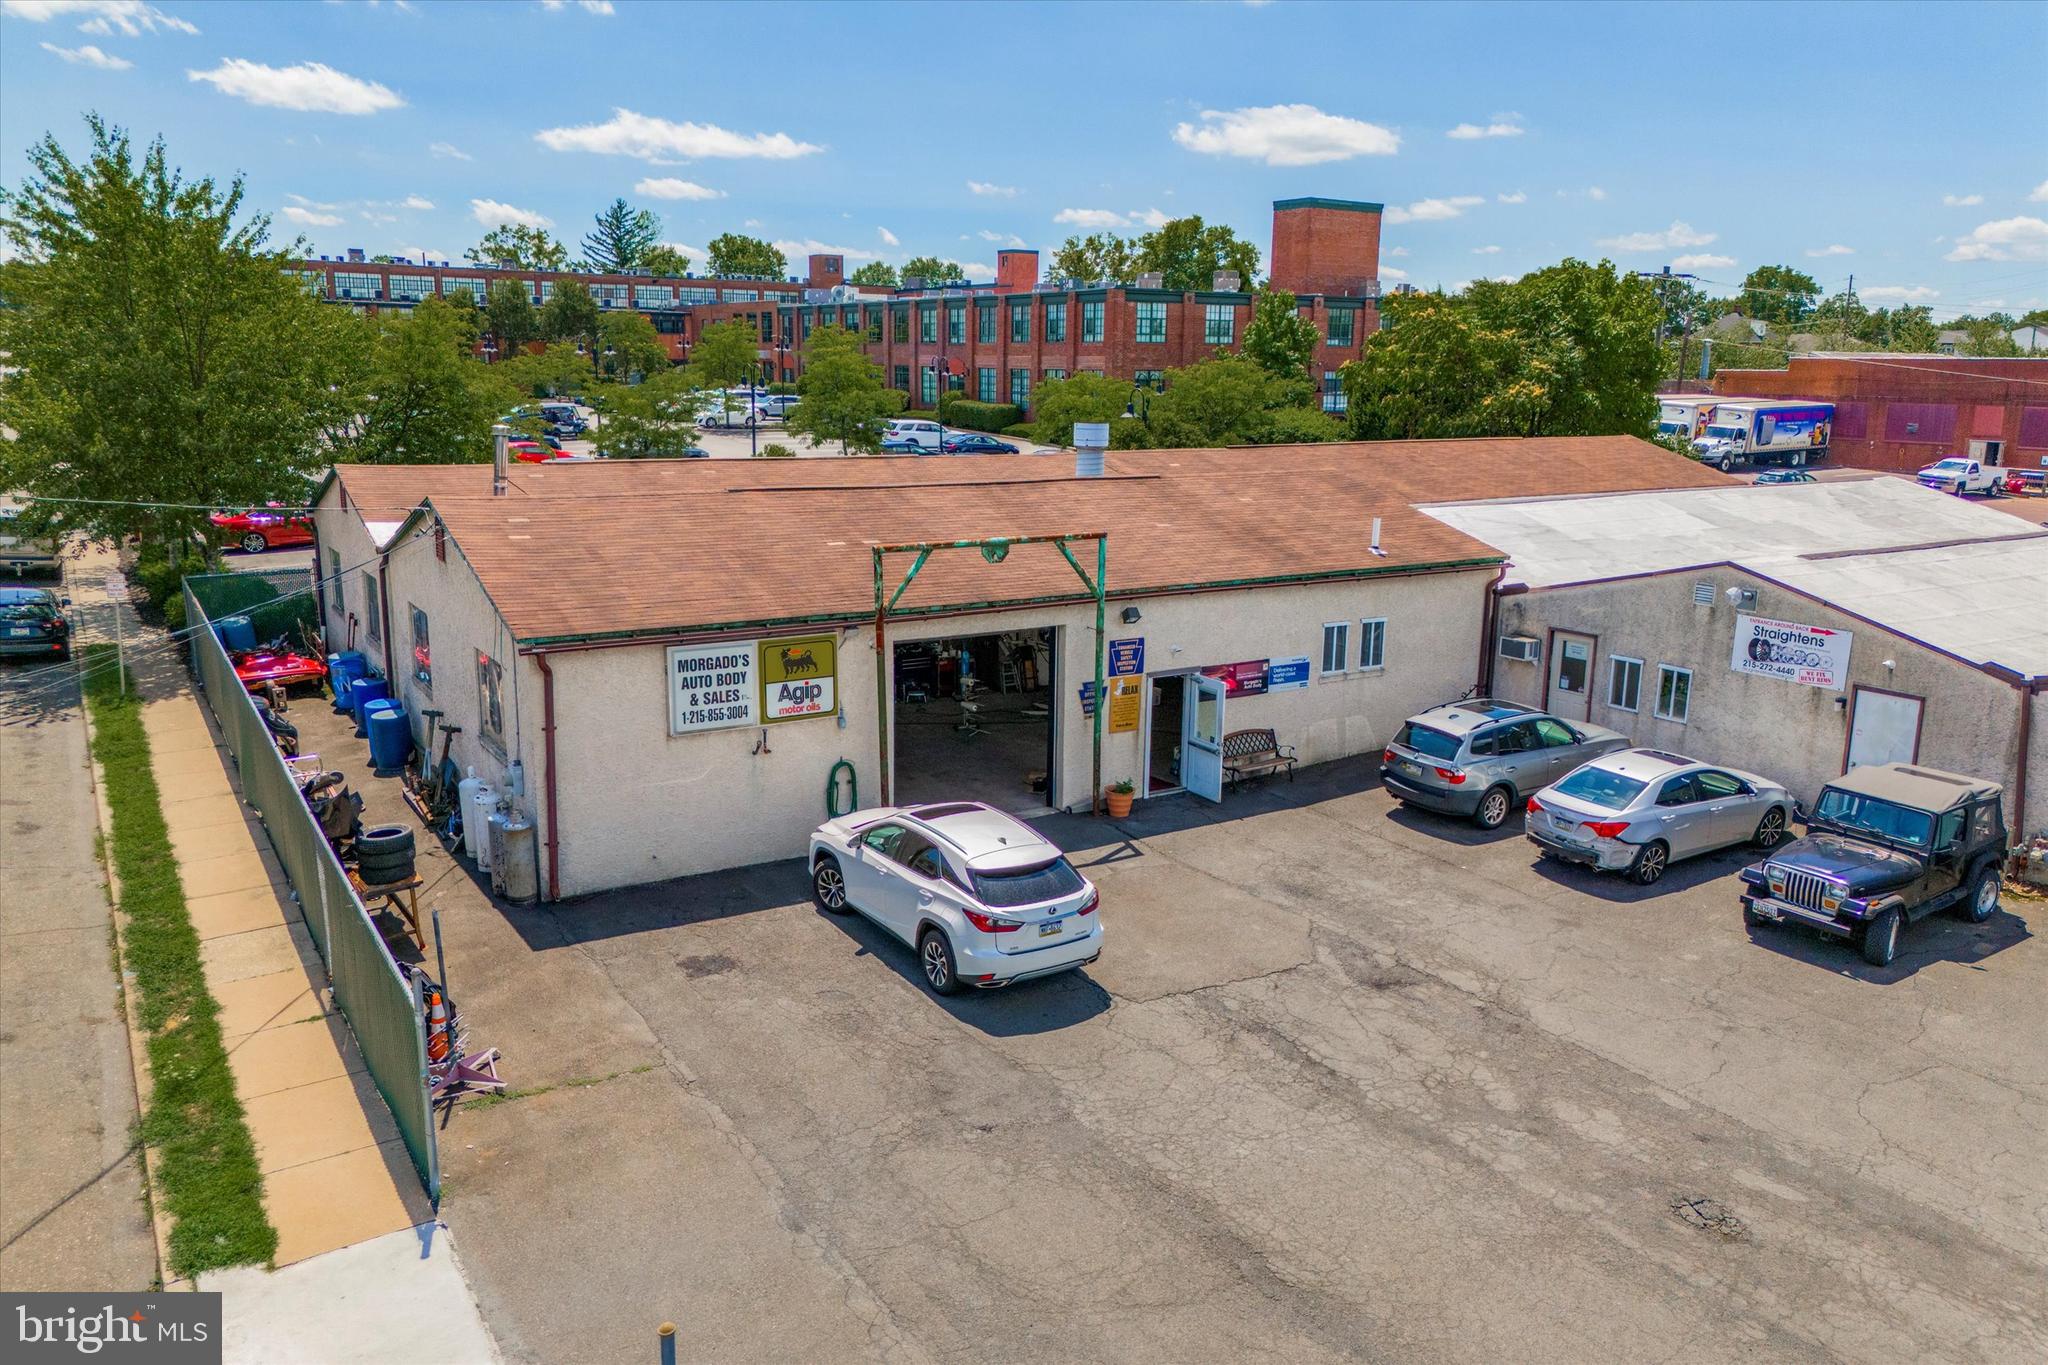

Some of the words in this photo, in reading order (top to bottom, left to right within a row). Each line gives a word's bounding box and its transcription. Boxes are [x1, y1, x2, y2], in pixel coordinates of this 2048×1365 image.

[1750, 617, 1773, 626] ENTRANCE
[1774, 622, 1794, 630] AROUND
[1753, 625, 1825, 647] Straightens
[677, 654, 750, 673] MORGADO'S
[1743, 659, 1795, 675] 215-272-4440
[681, 675, 713, 690] AUTO
[716, 671, 747, 687] BODY
[689, 693, 699, 706] &
[703, 689, 740, 705] SALES
[778, 681, 822, 705] Agip
[1121, 685, 1138, 696] RELAX
[779, 706, 804, 716] motor
[805, 704, 821, 713] oils
